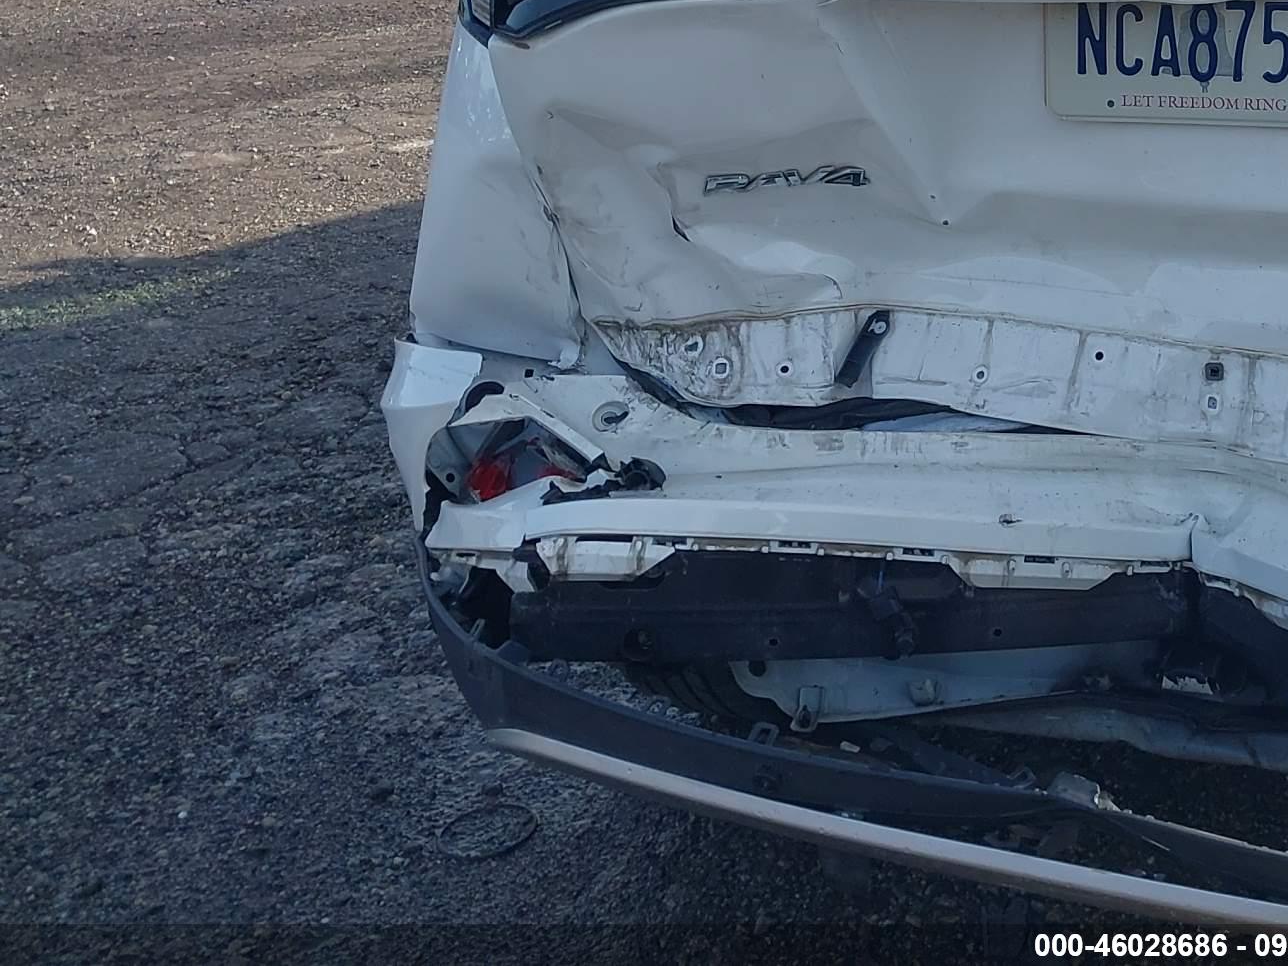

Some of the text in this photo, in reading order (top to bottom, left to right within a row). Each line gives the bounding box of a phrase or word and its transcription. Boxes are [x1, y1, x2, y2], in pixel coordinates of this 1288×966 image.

[1121, 94, 1288, 113] LET FREEDOM RING
[703, 164, 871, 196] RAV4
